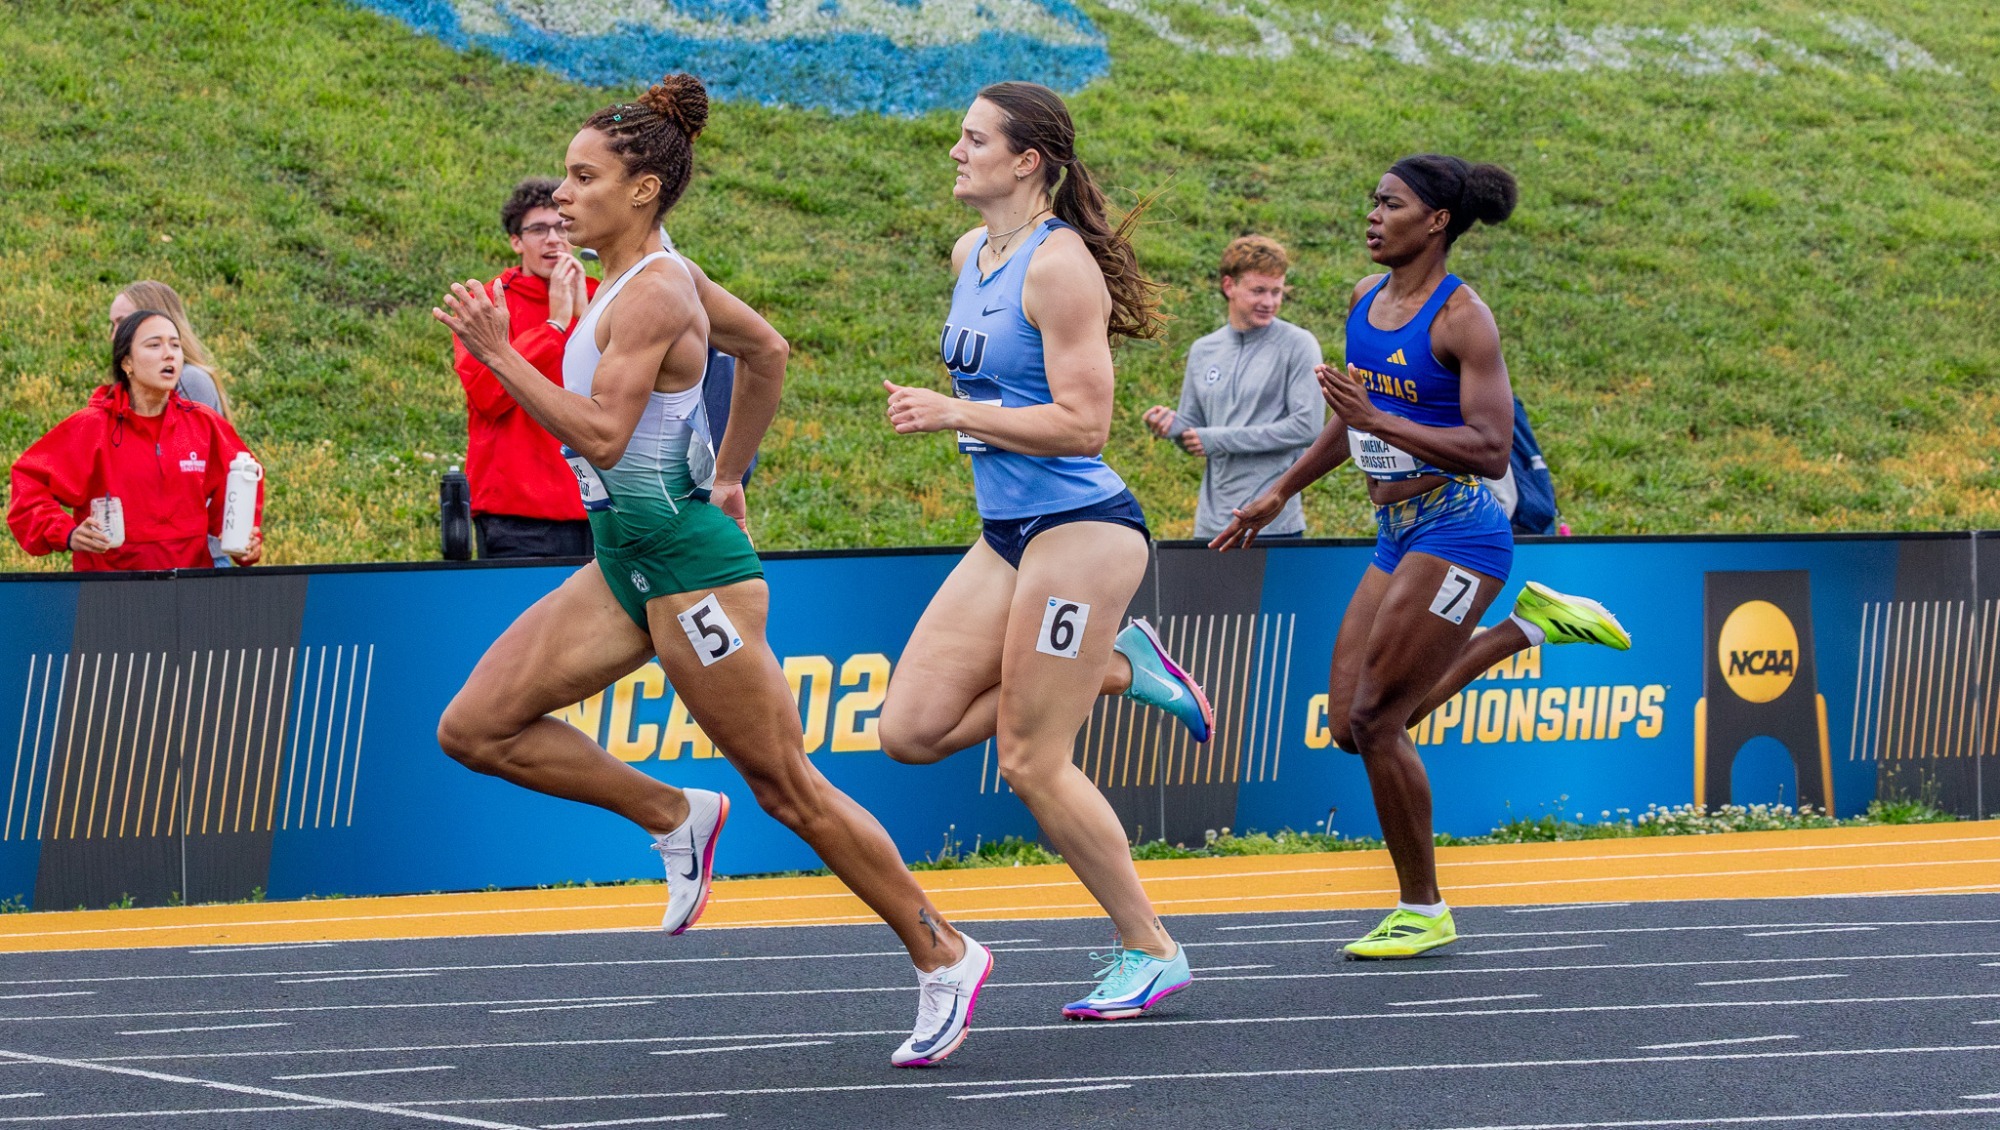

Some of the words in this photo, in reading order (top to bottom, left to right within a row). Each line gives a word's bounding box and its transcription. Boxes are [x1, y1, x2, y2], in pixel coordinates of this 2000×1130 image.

[940, 323, 989, 376] W
[1355, 368, 1418, 403] ELINAS
[1360, 439, 1390, 453] ONEIKA
[1360, 455, 1398, 468] BRISSETT
[1440, 574, 1472, 615] 7
[691, 604, 729, 659] 5
[1050, 603, 1079, 651] 6
[1728, 649, 1794, 677] NCAA
[782, 653, 892, 754] D2
[1304, 684, 1666, 749] CPIONSHIPS
